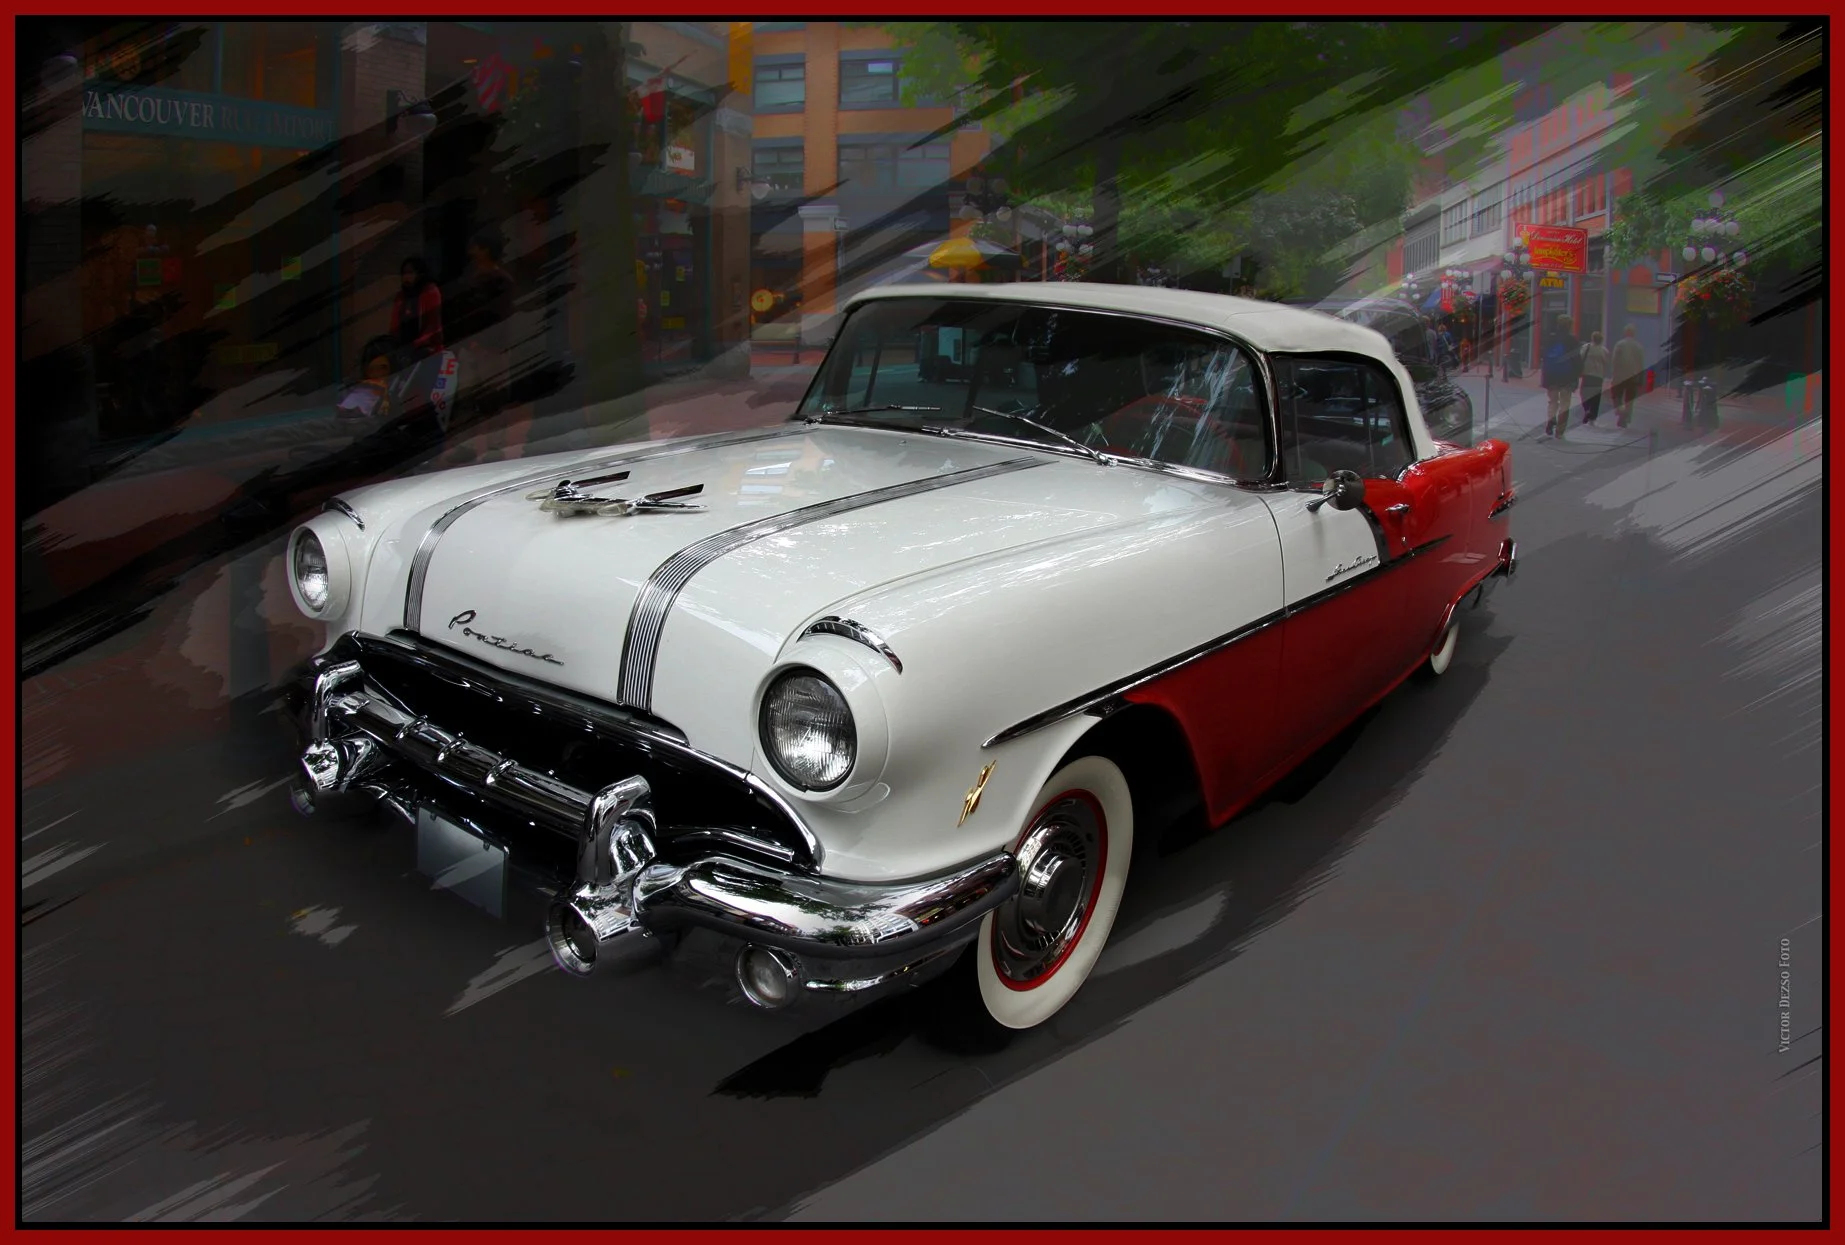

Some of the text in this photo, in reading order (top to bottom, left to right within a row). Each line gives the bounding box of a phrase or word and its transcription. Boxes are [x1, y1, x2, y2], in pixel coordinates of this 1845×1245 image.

[82, 90, 214, 129] VANCOUVER
[1539, 278, 1565, 288] ATM
[448, 609, 564, 666] Pontiac
